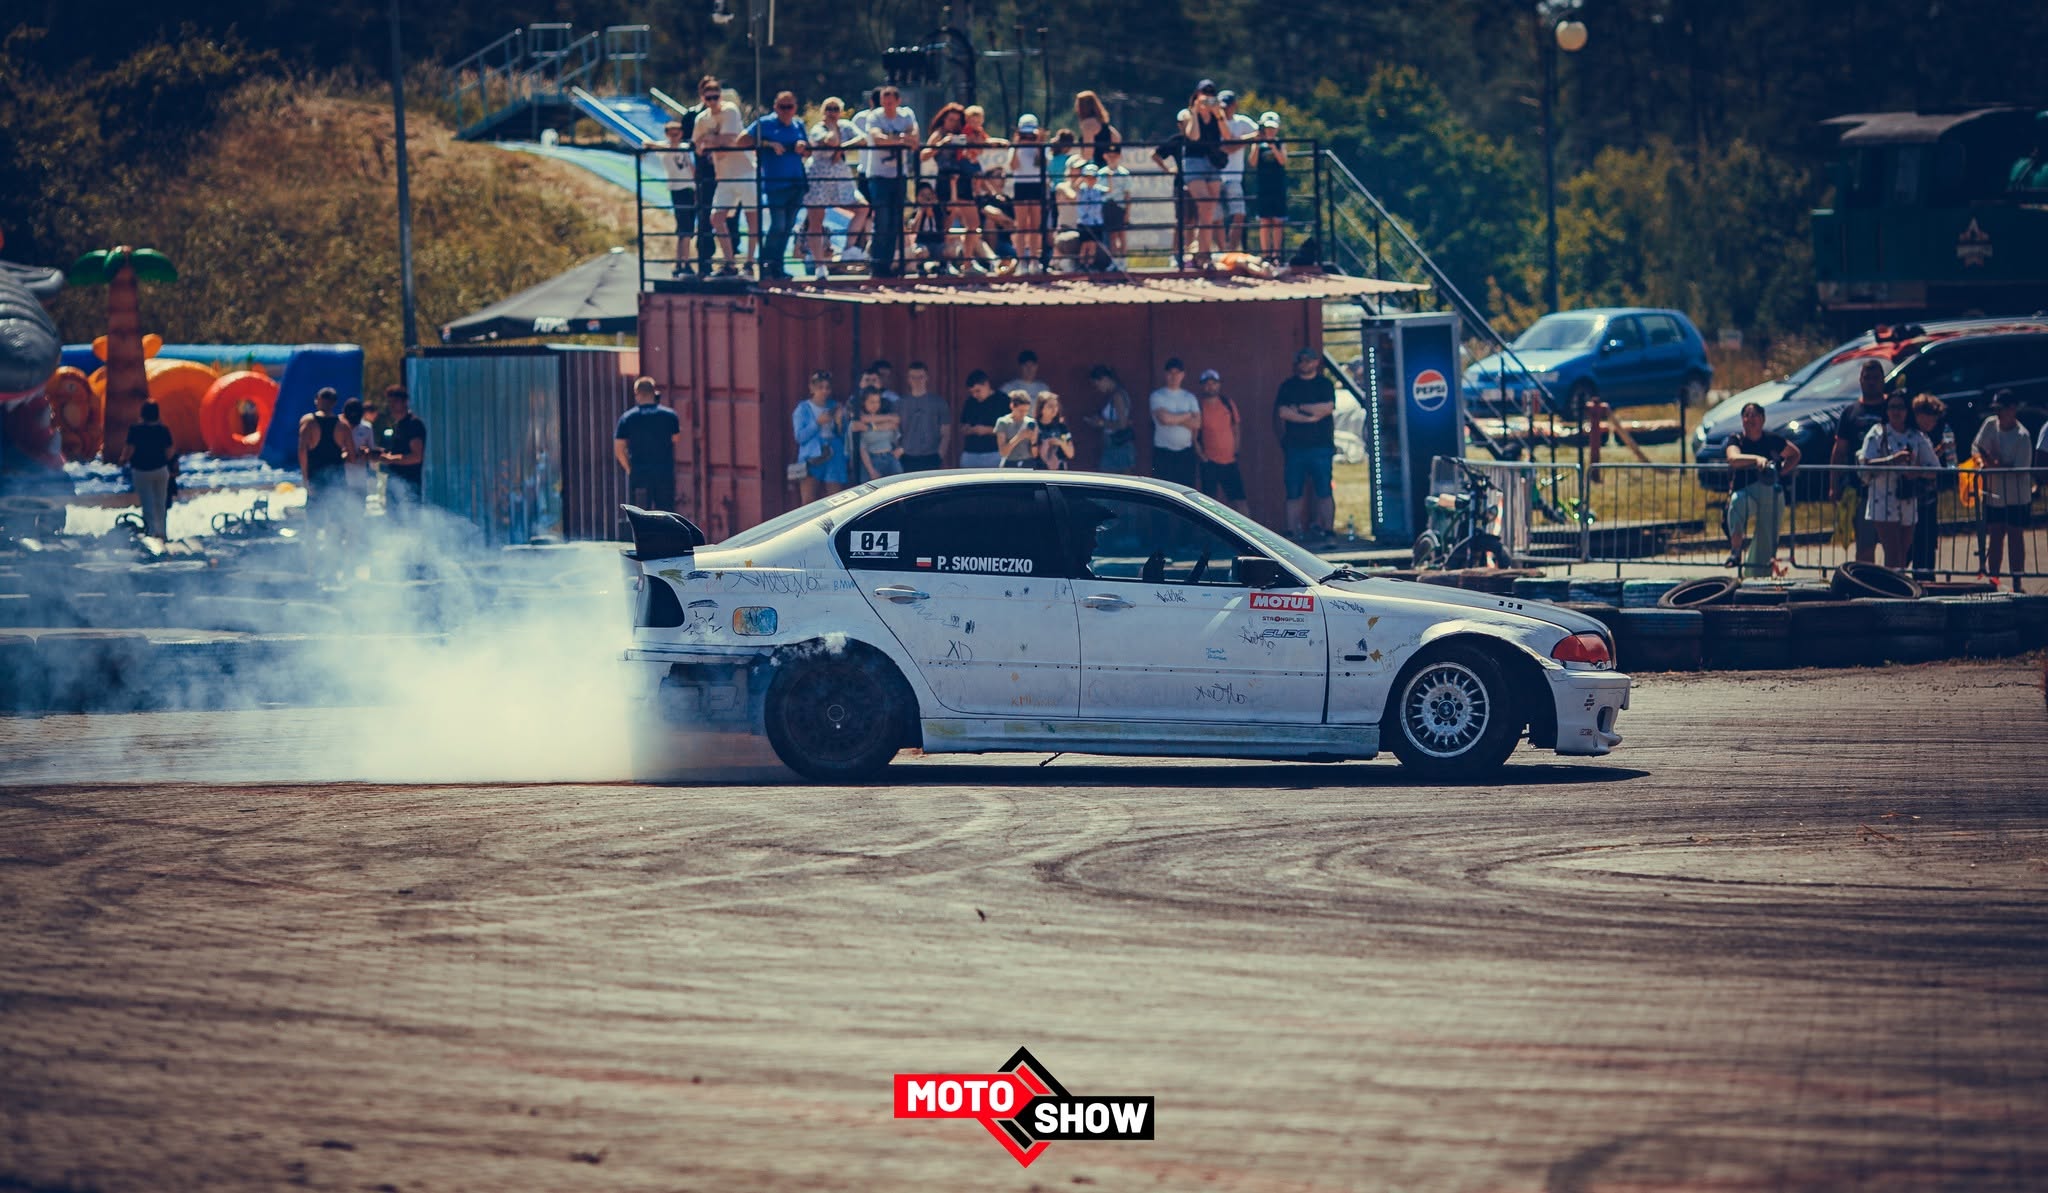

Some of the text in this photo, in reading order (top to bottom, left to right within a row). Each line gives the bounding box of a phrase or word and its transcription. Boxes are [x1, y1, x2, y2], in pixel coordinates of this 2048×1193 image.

[1416, 385, 1446, 395] PEPSI
[861, 533, 889, 551] 04
[937, 555, 1033, 574] P. SKONIECZKO
[1253, 595, 1311, 609] MOTUL
